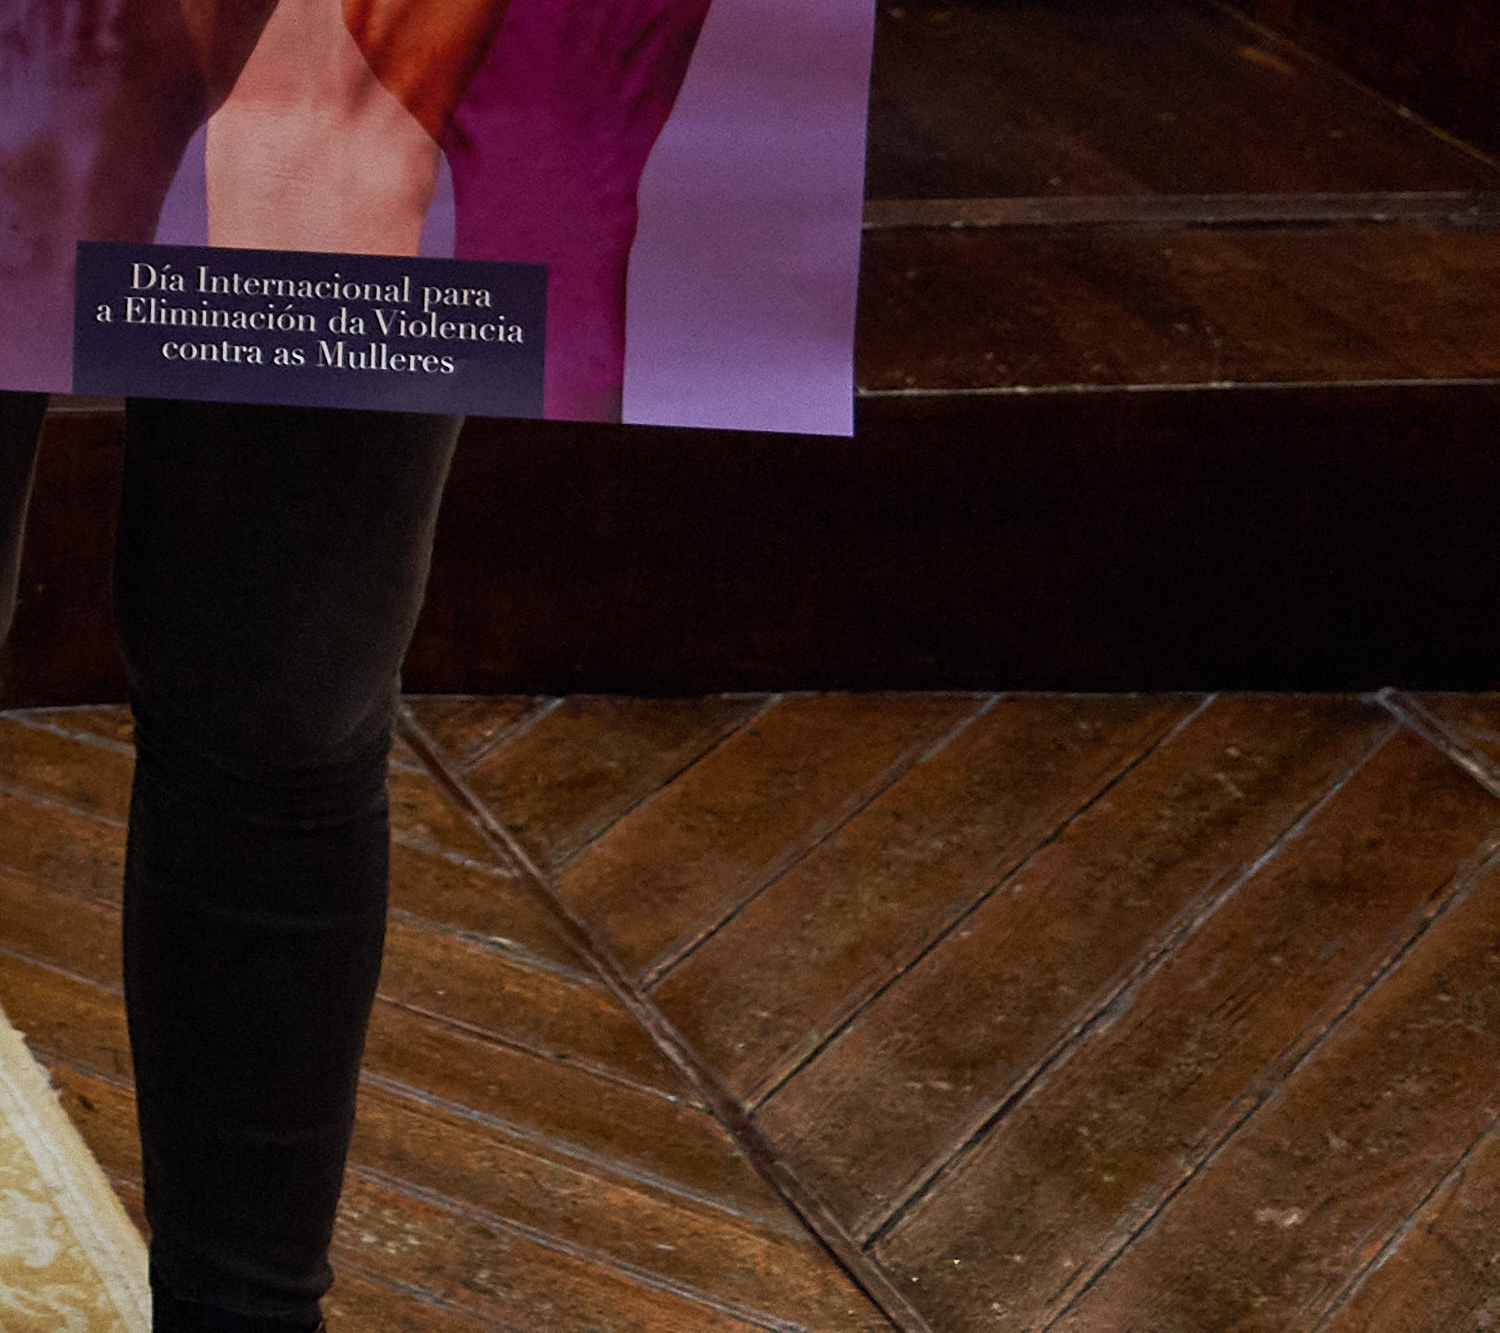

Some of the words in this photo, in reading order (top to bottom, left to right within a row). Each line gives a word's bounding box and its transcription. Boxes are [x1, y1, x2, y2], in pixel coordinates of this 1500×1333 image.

[131, 263, 185, 293] Día
[198, 265, 409, 303] Internacional
[422, 286, 491, 312] para
[95, 304, 111, 322] a
[125, 297, 316, 332] Eliminación
[329, 307, 366, 335] da
[369, 306, 524, 343] Violencia
[161, 340, 263, 364] contra
[273, 347, 305, 365] as
[317, 339, 455, 374] Mulleres
